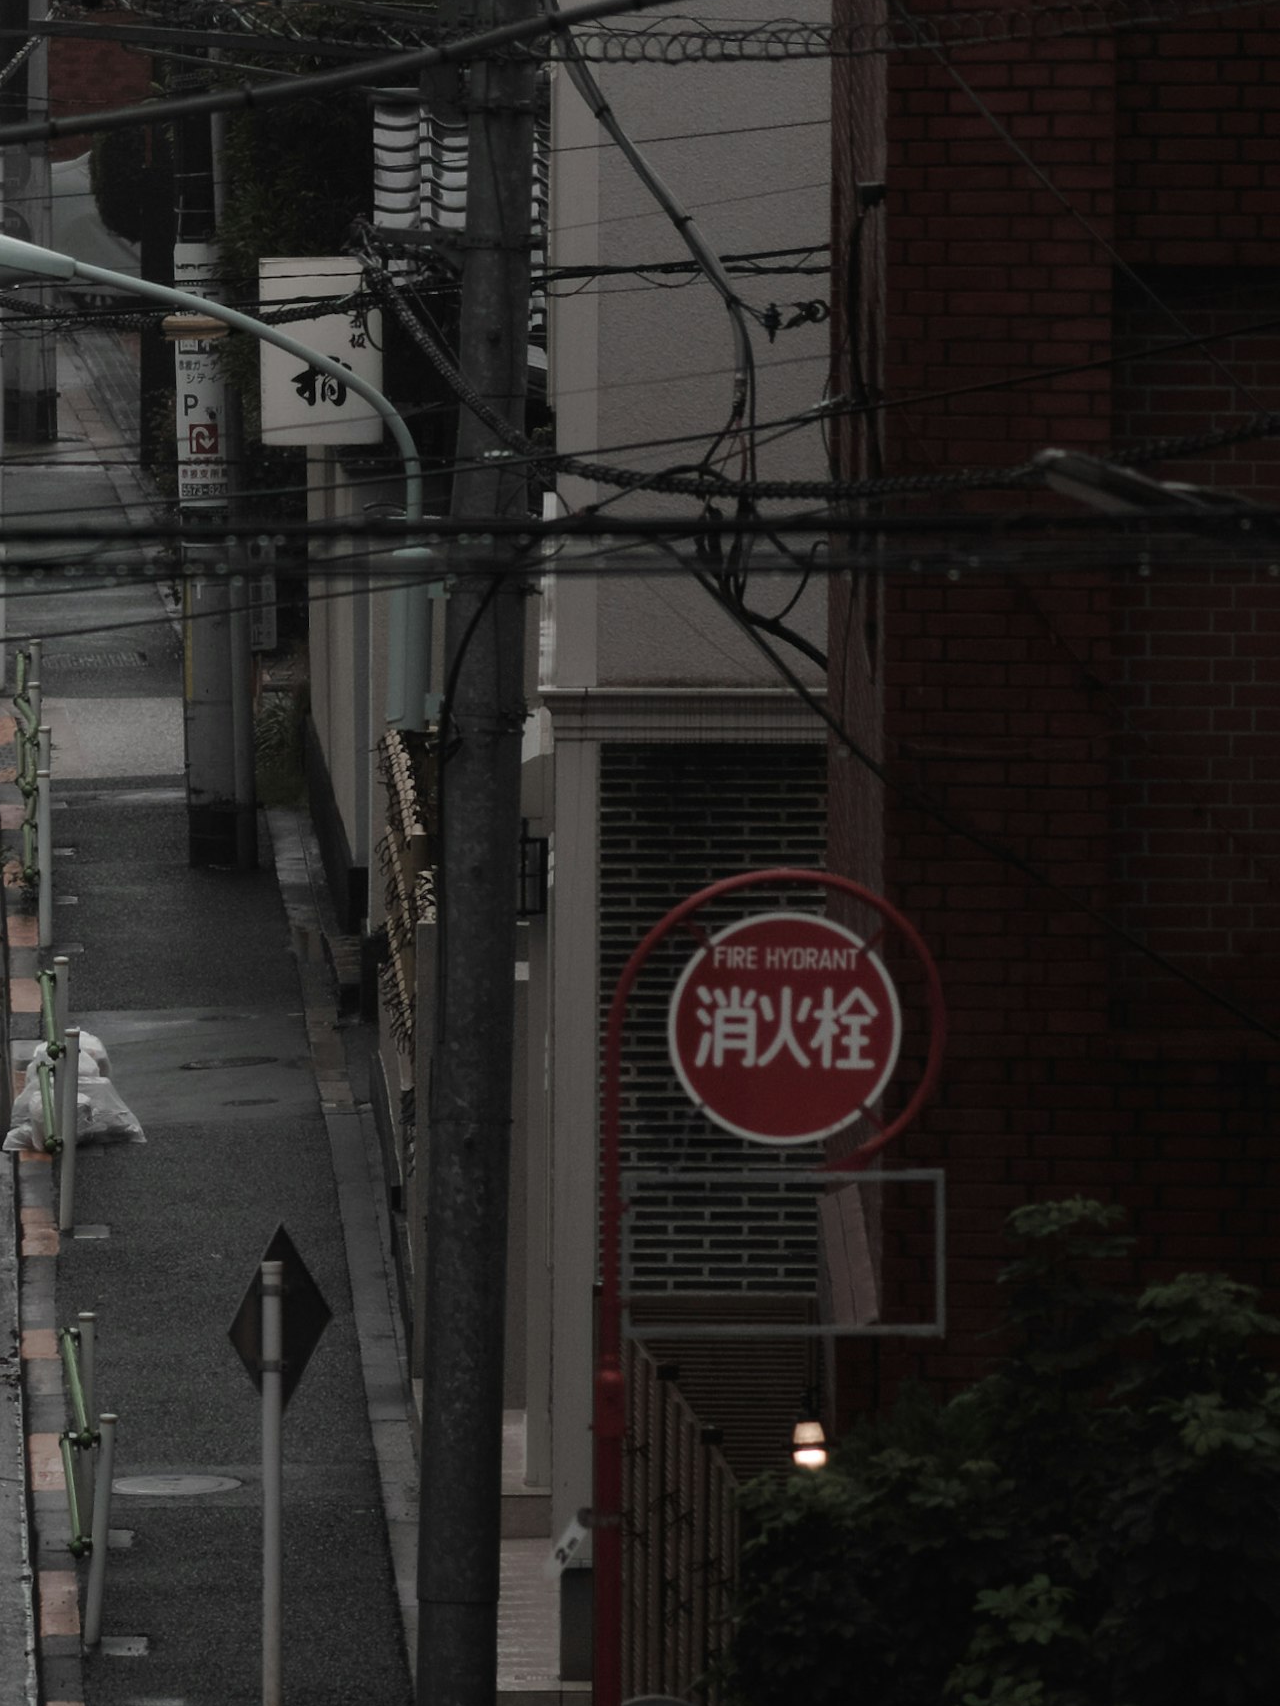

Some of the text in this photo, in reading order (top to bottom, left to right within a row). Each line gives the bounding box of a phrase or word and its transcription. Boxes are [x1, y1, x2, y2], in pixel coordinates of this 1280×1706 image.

[184, 394, 199, 417] P
[713, 946, 861, 972] FIRE HYDRANT
[695, 984, 880, 1070] 消火栓
